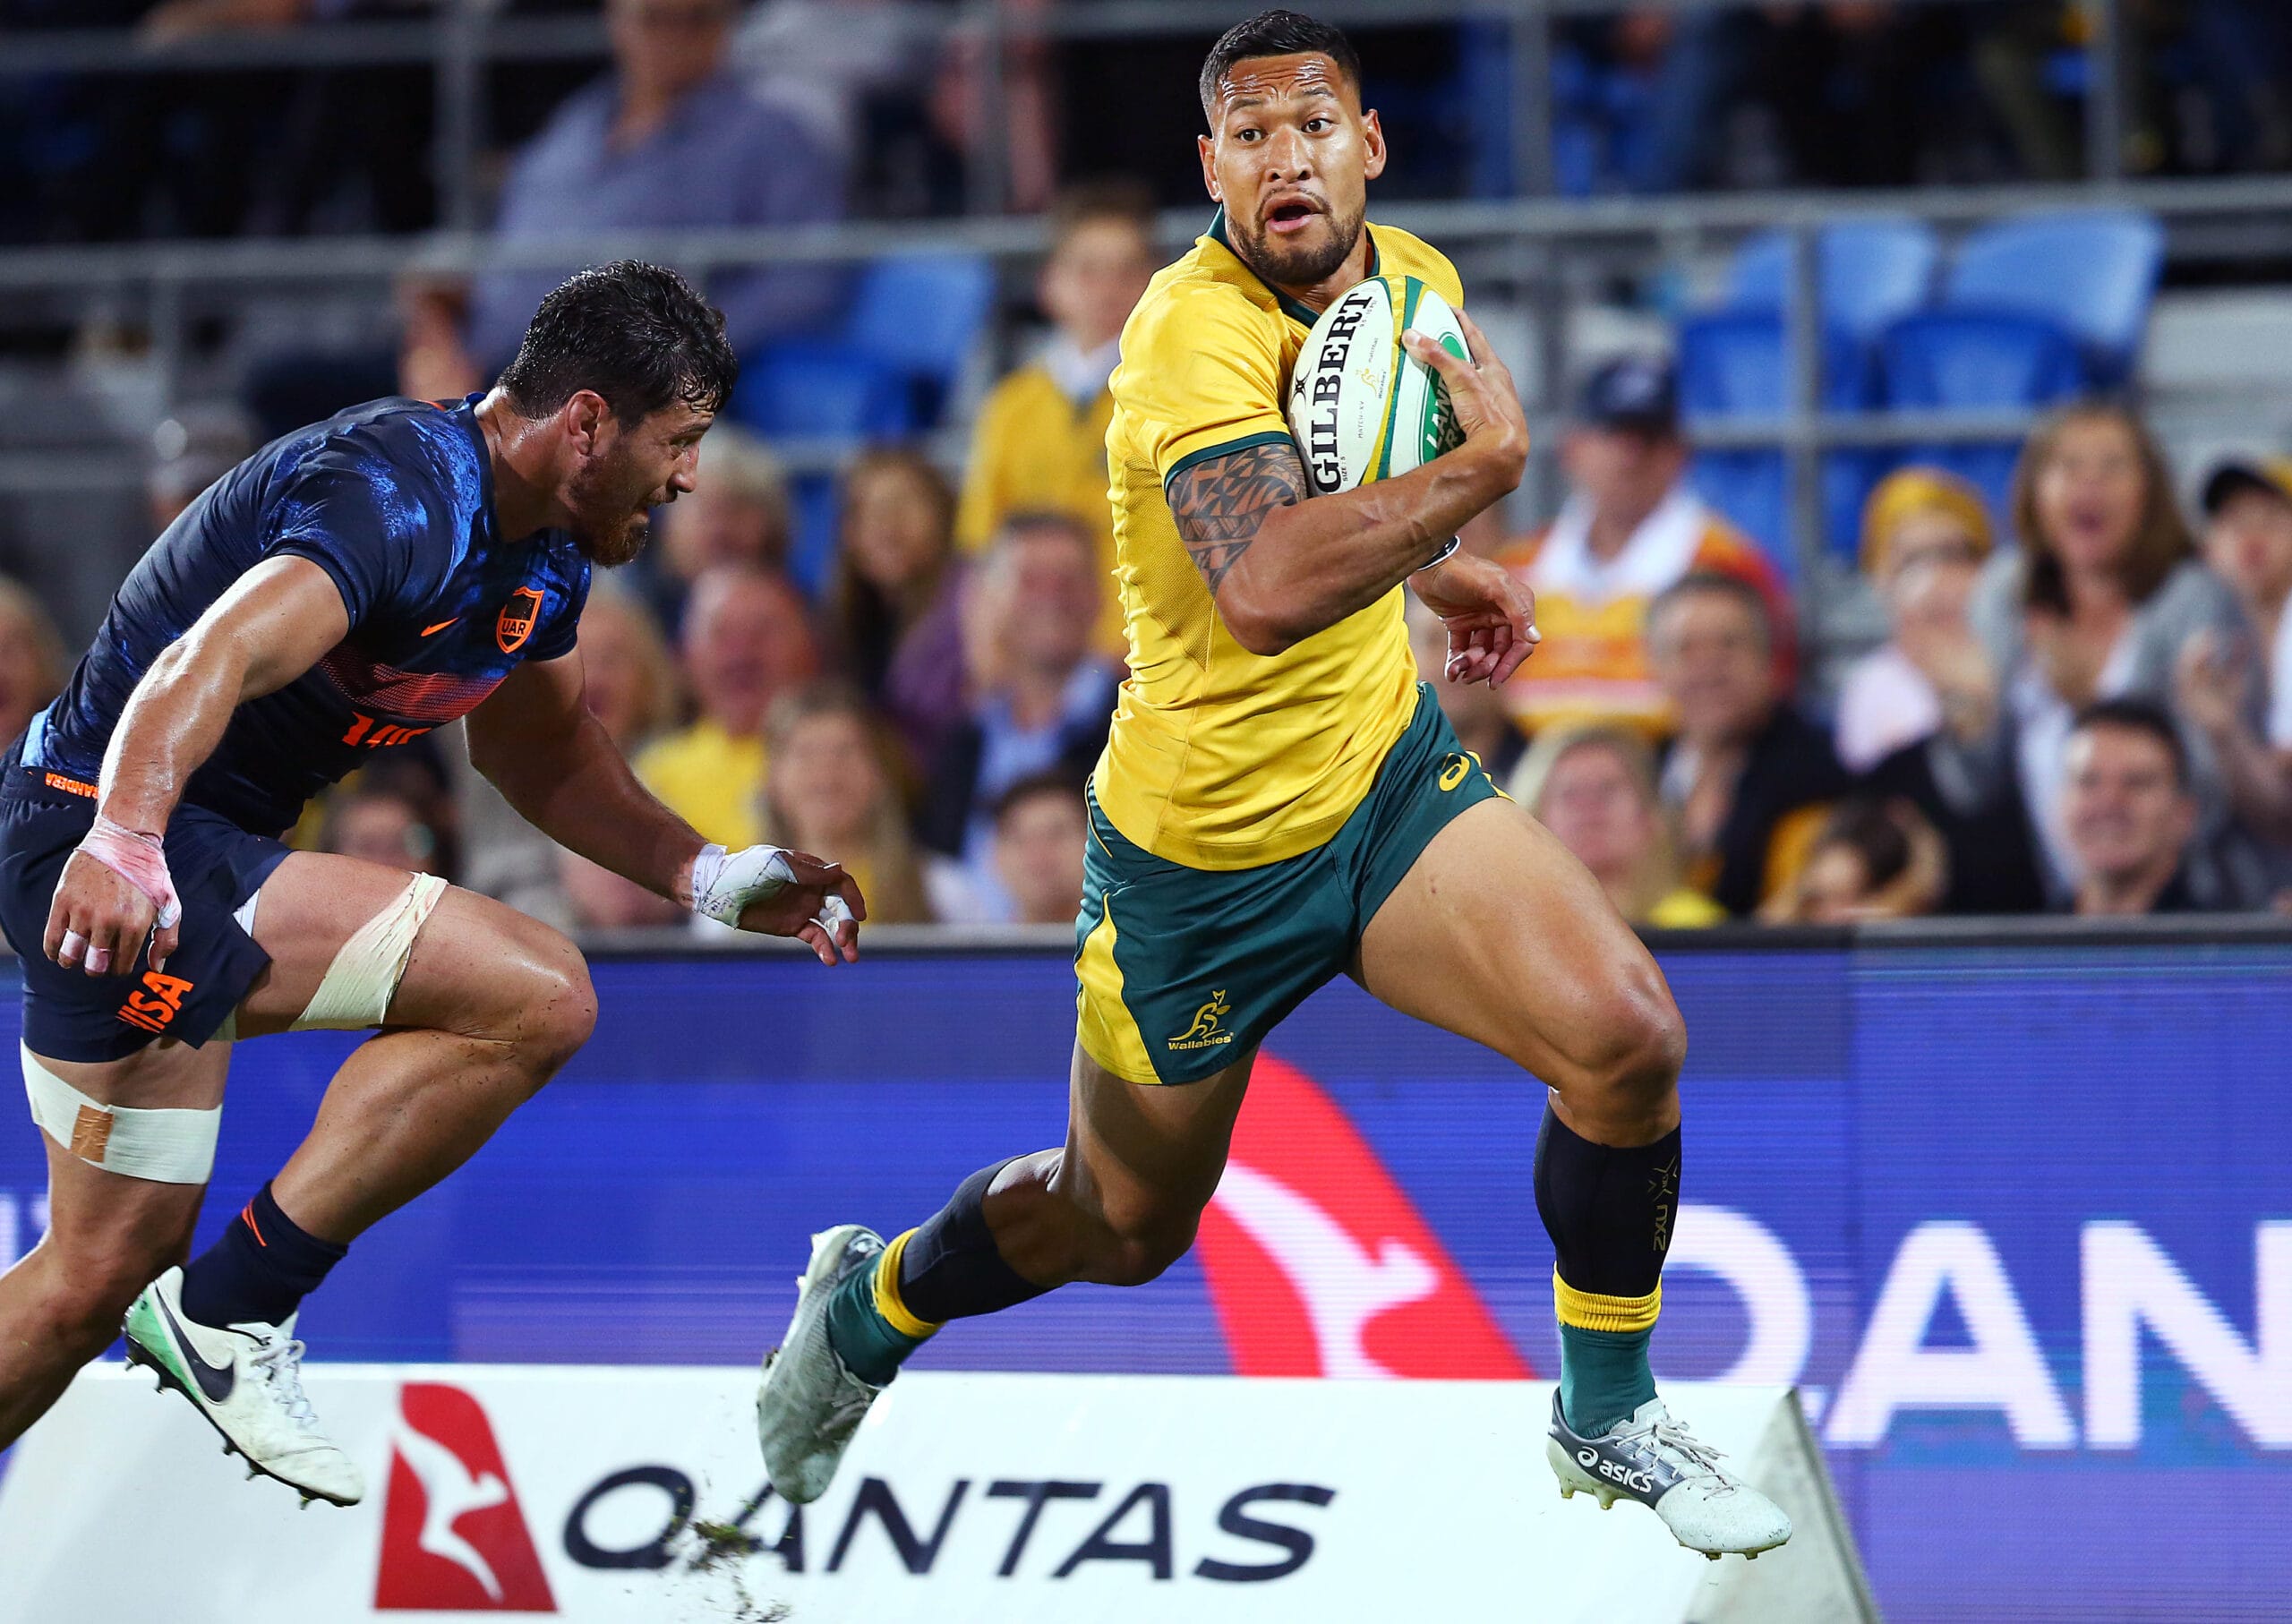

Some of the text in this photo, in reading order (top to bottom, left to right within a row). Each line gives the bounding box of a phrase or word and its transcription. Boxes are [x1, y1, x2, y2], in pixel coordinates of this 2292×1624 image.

[1311, 293, 1373, 492] GILBERT
[502, 620, 526, 635] UAR
[1168, 1036, 1232, 1050] Wallabies
[1654, 1204, 1668, 1251] 2XU
[1599, 1458, 1655, 1493] asics
[563, 1465, 1336, 1582] QANTAS
